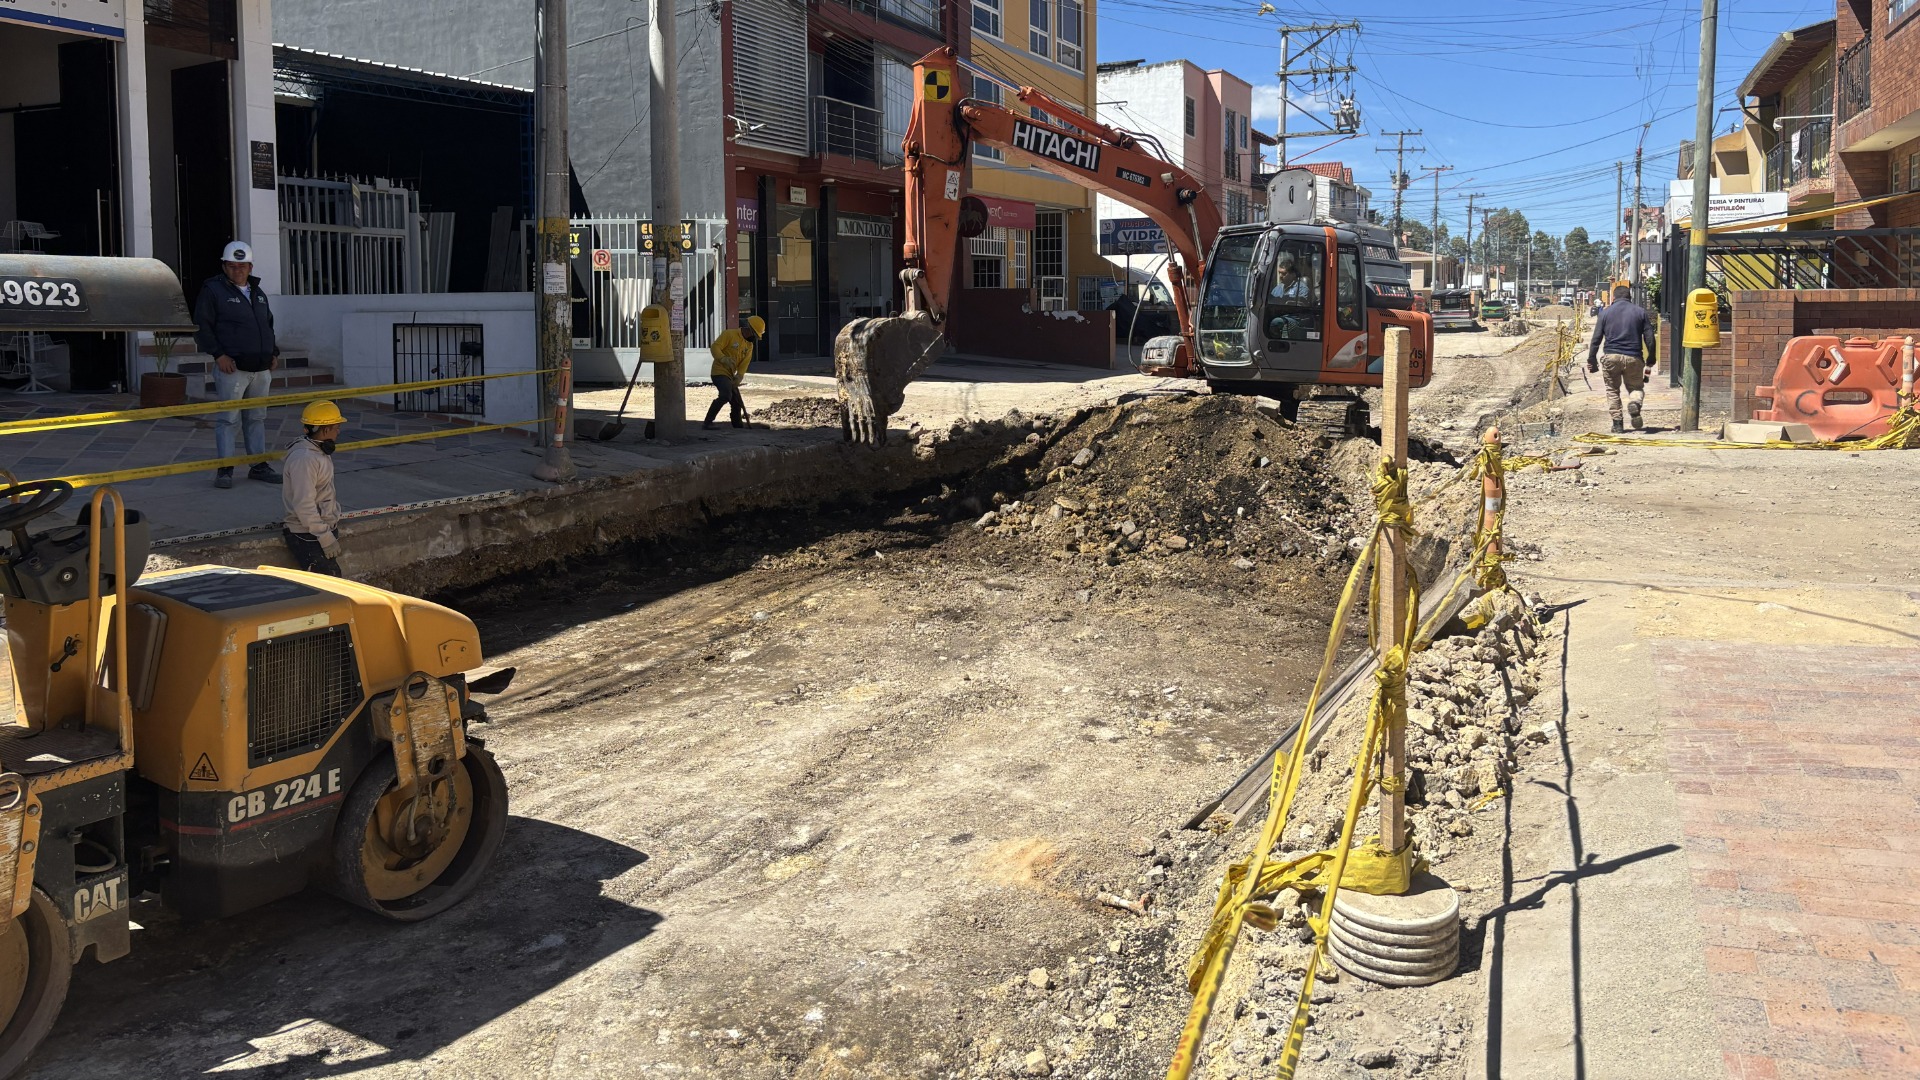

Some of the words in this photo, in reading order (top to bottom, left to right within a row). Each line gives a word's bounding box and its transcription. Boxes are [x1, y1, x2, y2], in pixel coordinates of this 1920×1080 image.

[1013, 121, 1097, 170] HITACHI
[736, 204, 757, 221] nter
[1709, 204, 1745, 212] PINTULEÓN
[844, 220, 892, 238] MONTADOR
[228, 790, 266, 824] CB
[272, 773, 322, 811] 224
[328, 767, 341, 794] E
[74, 876, 121, 924] CAT
